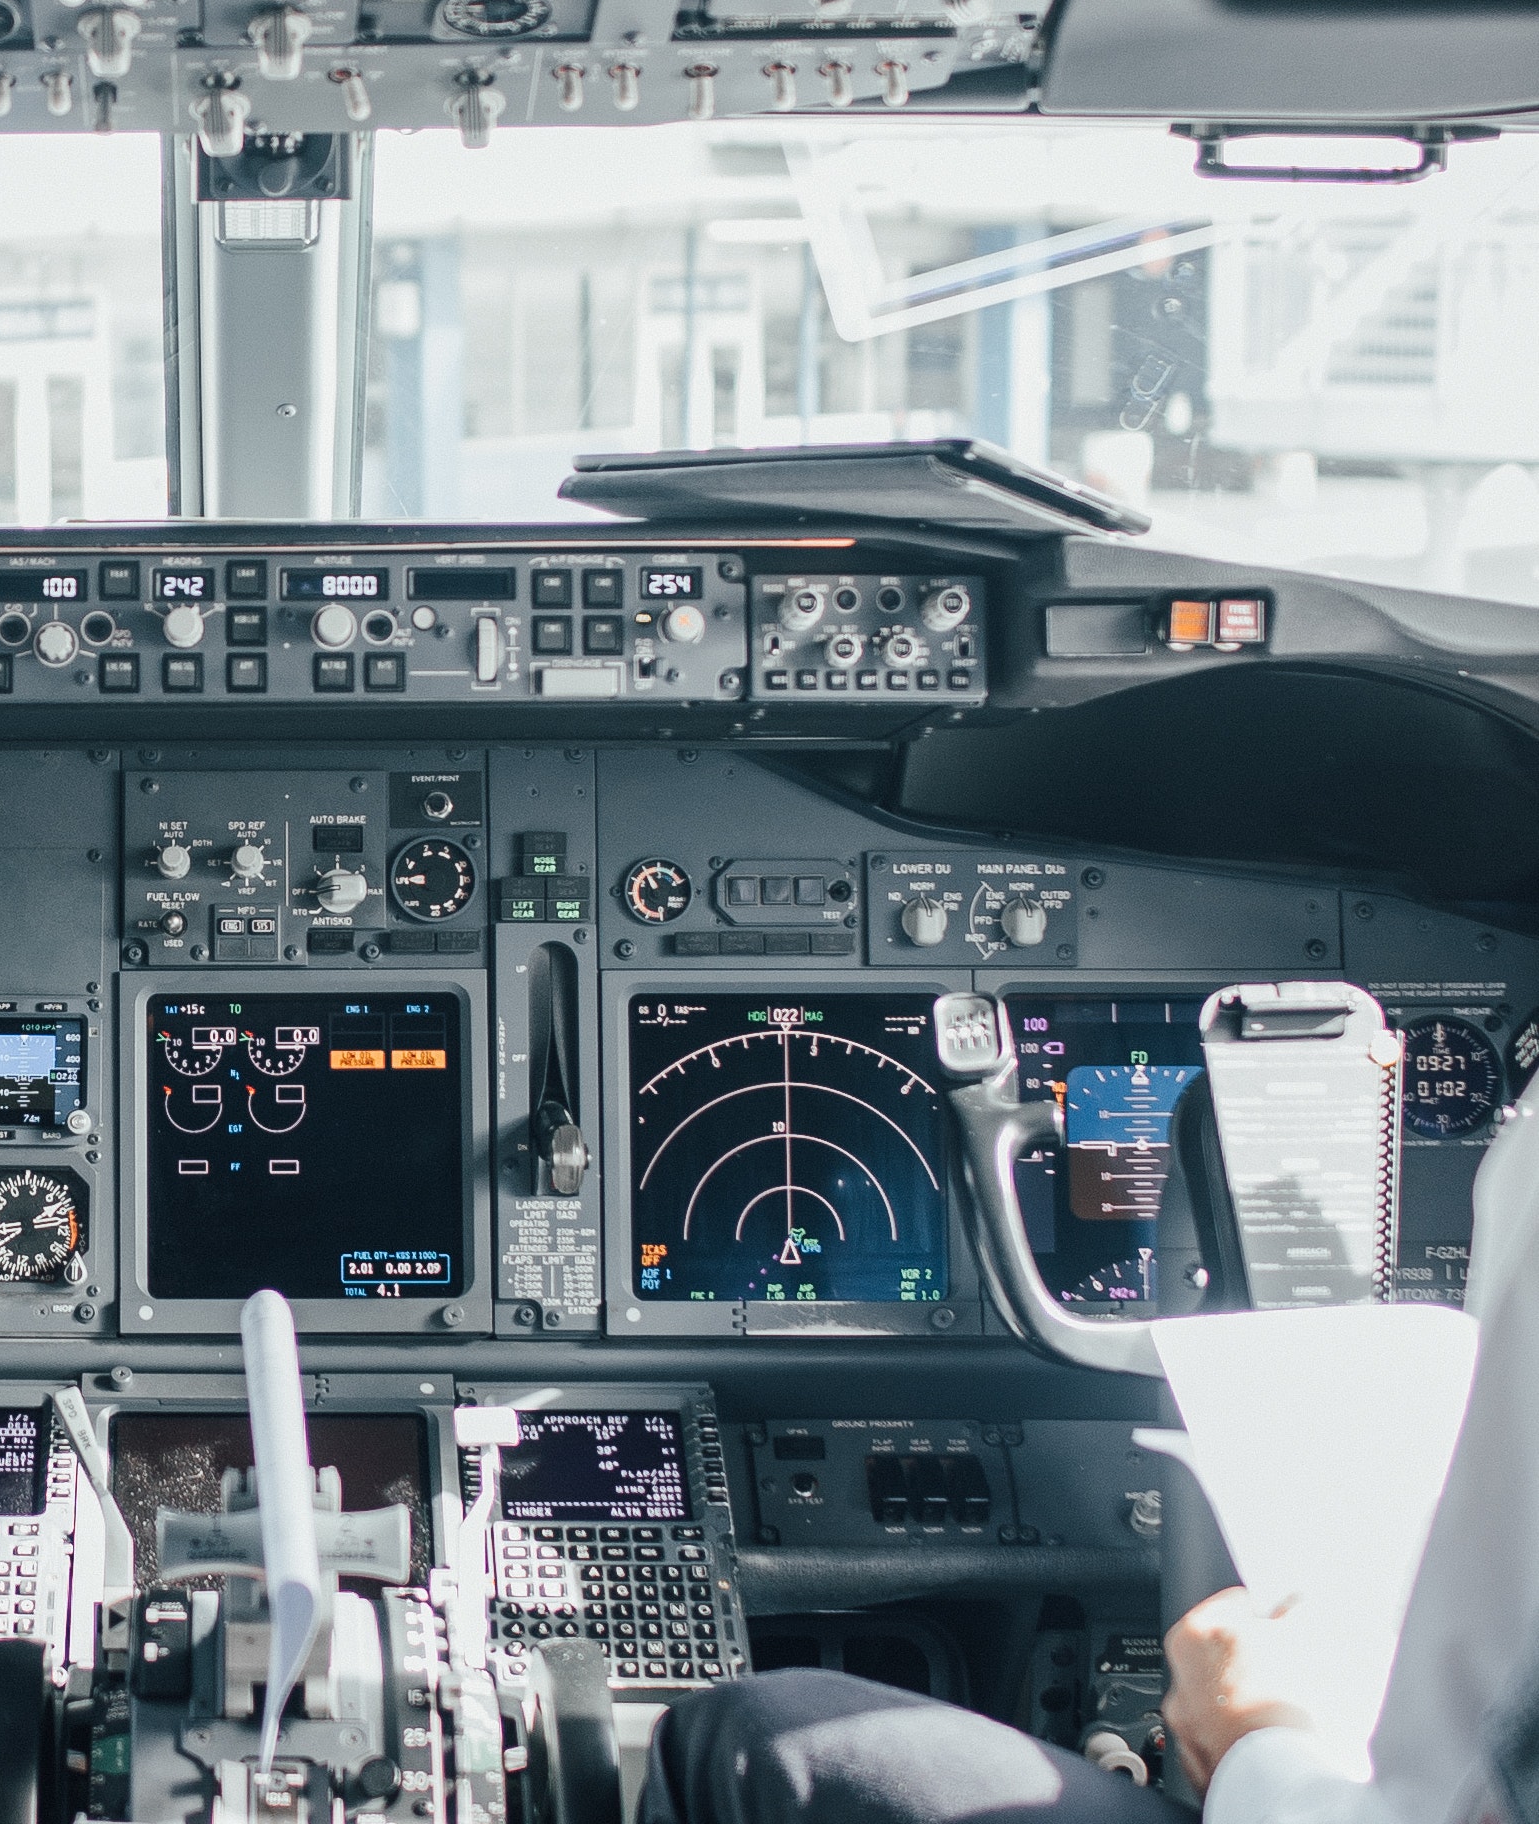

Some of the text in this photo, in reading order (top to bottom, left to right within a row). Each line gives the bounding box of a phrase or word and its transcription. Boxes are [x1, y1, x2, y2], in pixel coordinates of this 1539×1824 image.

[9, 558, 56, 567] IAS/MACH
[162, 556, 203, 566] HEADING
[314, 555, 353, 565] ALTITUDE
[42, 577, 78, 598] 100
[163, 576, 204, 596] 242
[322, 576, 378, 596] 8000
[648, 574, 691, 595] 254
[309, 815, 366, 824] AUTO BRAKE
[171, 821, 188, 830] SET
[228, 821, 266, 830] SPD REF
[192, 839, 212, 847] BOTH
[533, 856, 556, 865] NOSE
[534, 864, 556, 873] GEAR
[892, 863, 951, 875] LOWER DU
[977, 864, 1004, 874] MAIN
[1006, 864, 1042, 874] PANEL
[909, 882, 936, 891] NORM
[1009, 882, 1034, 891] NORM
[292, 888, 307, 896] OFF
[368, 888, 383, 896] MAX
[888, 892, 902, 901] ND
[943, 892, 962, 901] ENG
[986, 891, 1005, 900] ENG
[1040, 891, 1071, 900] OUTBD
[146, 892, 200, 902] FUEL FLOW
[161, 901, 185, 909] RESET
[513, 901, 534, 910] LEFT
[556, 901, 580, 910] RIGHT
[1043, 900, 1062, 909] PFD
[237, 907, 256, 915] MFD
[513, 909, 535, 918] GEAR
[557, 909, 580, 918] GEAR
[823, 911, 841, 920] TEST
[312, 917, 353, 926] ANTISKID
[974, 916, 993, 925] PFD
[163, 939, 184, 948] USED
[229, 1004, 242, 1015] TO
[346, 1005, 369, 1014] ENG 1
[406, 1005, 430, 1014] ENG 2
[748, 1008, 823, 1022] HDG 022 MAG
[1023, 1018, 1048, 1032] 100
[209, 1029, 235, 1043] 0.0
[293, 1029, 318, 1043] 0.0
[1130, 1051, 1149, 1064] FD
[556, 1201, 582, 1210] GEAR
[641, 1244, 667, 1256] TCAS
[353, 1251, 372, 1260] FUEL
[374, 1251, 388, 1260] QTY
[411, 1251, 418, 1260] X
[418, 1251, 437, 1260] 1000
[641, 1255, 660, 1266] OFF
[348, 1263, 441, 1275] 2.01 0.00 2.09
[641, 1268, 672, 1279] ADF 1
[901, 1268, 932, 1279] VOR 2
[345, 1283, 401, 1297] TOTAL 4.1
[921, 1290, 940, 1301] 1.0
[543, 1415, 629, 1426] APPROACH REF
[610, 1507, 642, 1518] ALTN
[402, 1770, 429, 1791] 30
